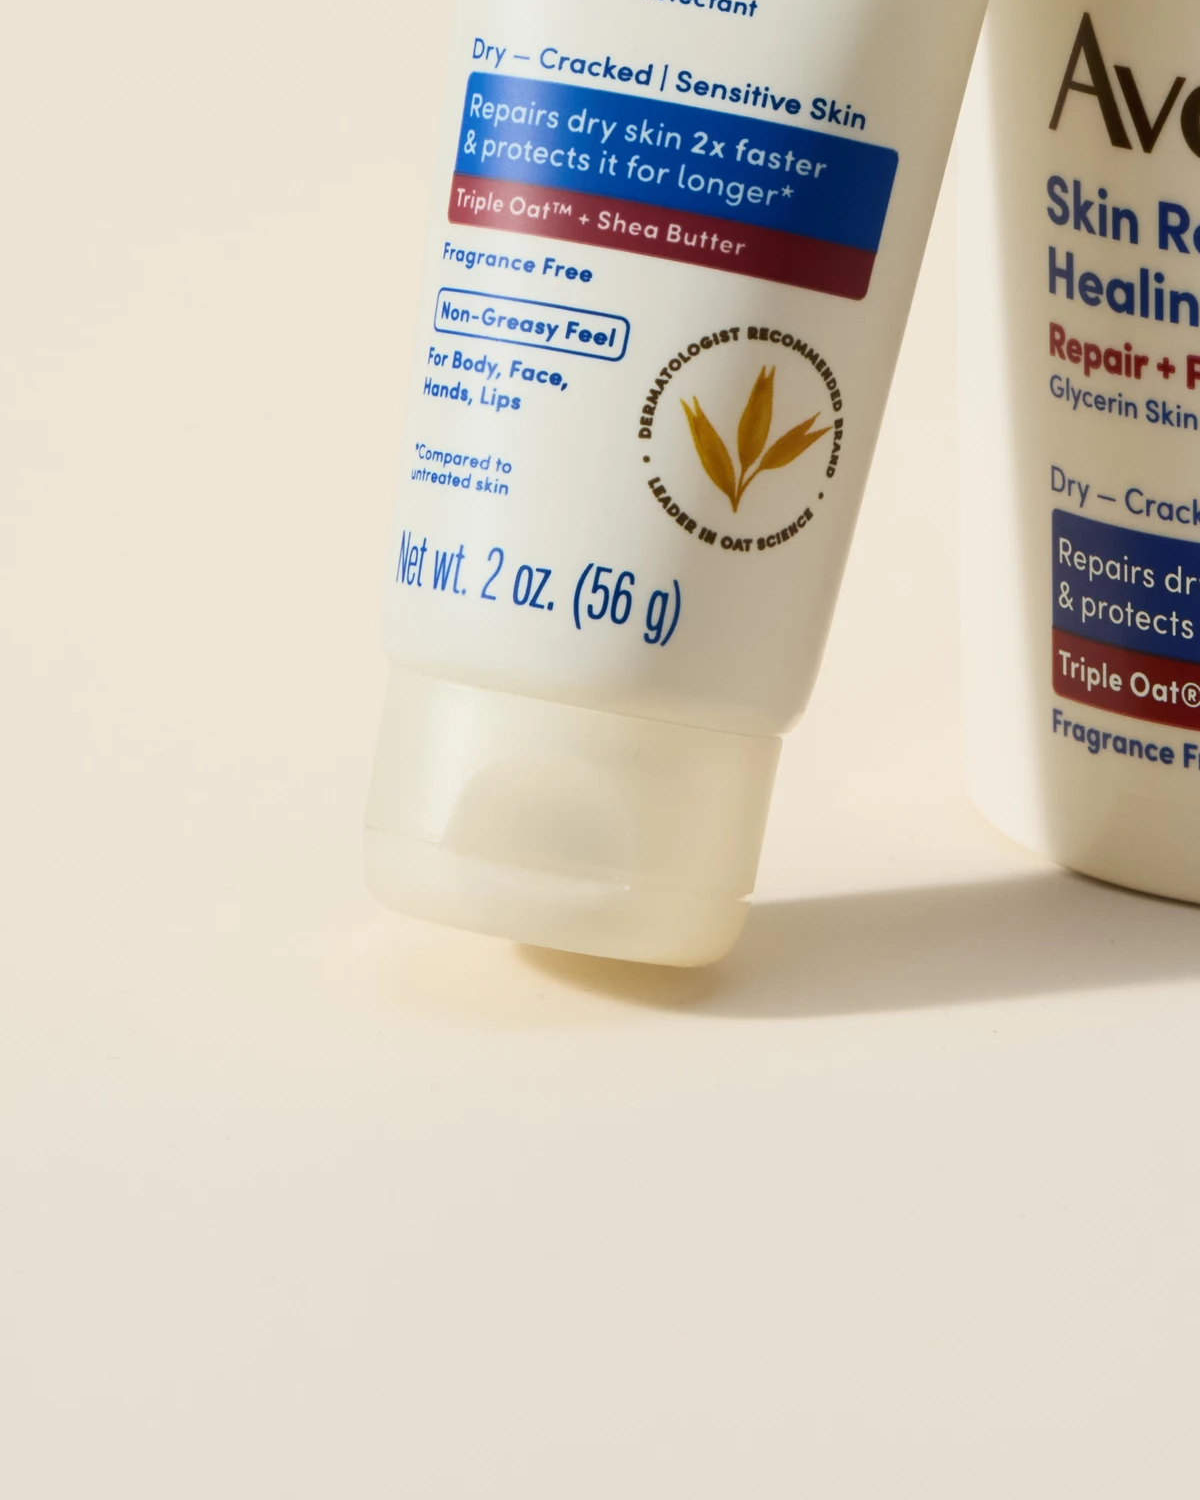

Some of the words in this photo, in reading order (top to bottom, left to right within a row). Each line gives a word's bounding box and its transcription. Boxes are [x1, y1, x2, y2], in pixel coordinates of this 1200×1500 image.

[472, 37, 507, 67] Dry
[539, 48, 652, 86] Cracked
[676, 71, 801, 115] Sensitive
[810, 98, 866, 130] Skin
[464, 131, 477, 154] &
[481, 136, 590, 176] protects
[599, 151, 617, 176] it
[626, 157, 671, 186] for
[470, 93, 559, 131] Repairs
[567, 108, 616, 143] dry
[625, 120, 681, 151] skin
[691, 131, 725, 160] 2x
[735, 139, 826, 178] faster
[456, 188, 503, 218] Triple
[579, 214, 590, 225] +
[597, 211, 659, 239] Shea
[666, 224, 746, 257] Butter
[1046, 175, 1140, 245] Skin
[443, 242, 536, 275] Fragrance
[542, 257, 593, 283] Free
[441, 301, 559, 342] Non-Greasy
[565, 322, 616, 348] Feel
[1049, 321, 1148, 383] Repair
[1156, 359, 1176, 378] +
[423, 377, 474, 406] Hands,
[480, 385, 521, 412] Lips
[428, 347, 447, 370] For
[452, 352, 502, 379] Body,
[509, 361, 569, 391] Face,
[638, 327, 740, 440] DERMATOLOGIST
[748, 327, 843, 413] RECOMMENDED
[825, 418, 843, 478] BRAND
[1050, 374, 1139, 421] Glycerin
[1144, 399, 1199, 431] Skin
[411, 468, 472, 491] untreated
[475, 477, 509, 496] skin
[496, 456, 512, 475] to
[1051, 464, 1091, 509] Dry
[648, 476, 697, 535] LEADER
[698, 526, 718, 547] IN
[720, 536, 753, 552] OAT
[756, 507, 814, 551] SCIENCE
[396, 529, 427, 588] Net
[433, 547, 467, 596] wt.
[480, 547, 504, 601] 2
[513, 566, 555, 612] oz.
[572, 562, 633, 630] (56
[645, 581, 681, 646] g)
[1058, 536, 1156, 592] Repairs
[1058, 582, 1075, 611] &
[1081, 589, 1196, 643] protects
[1058, 649, 1124, 699] Triple
[1052, 708, 1175, 765] Fragrance
